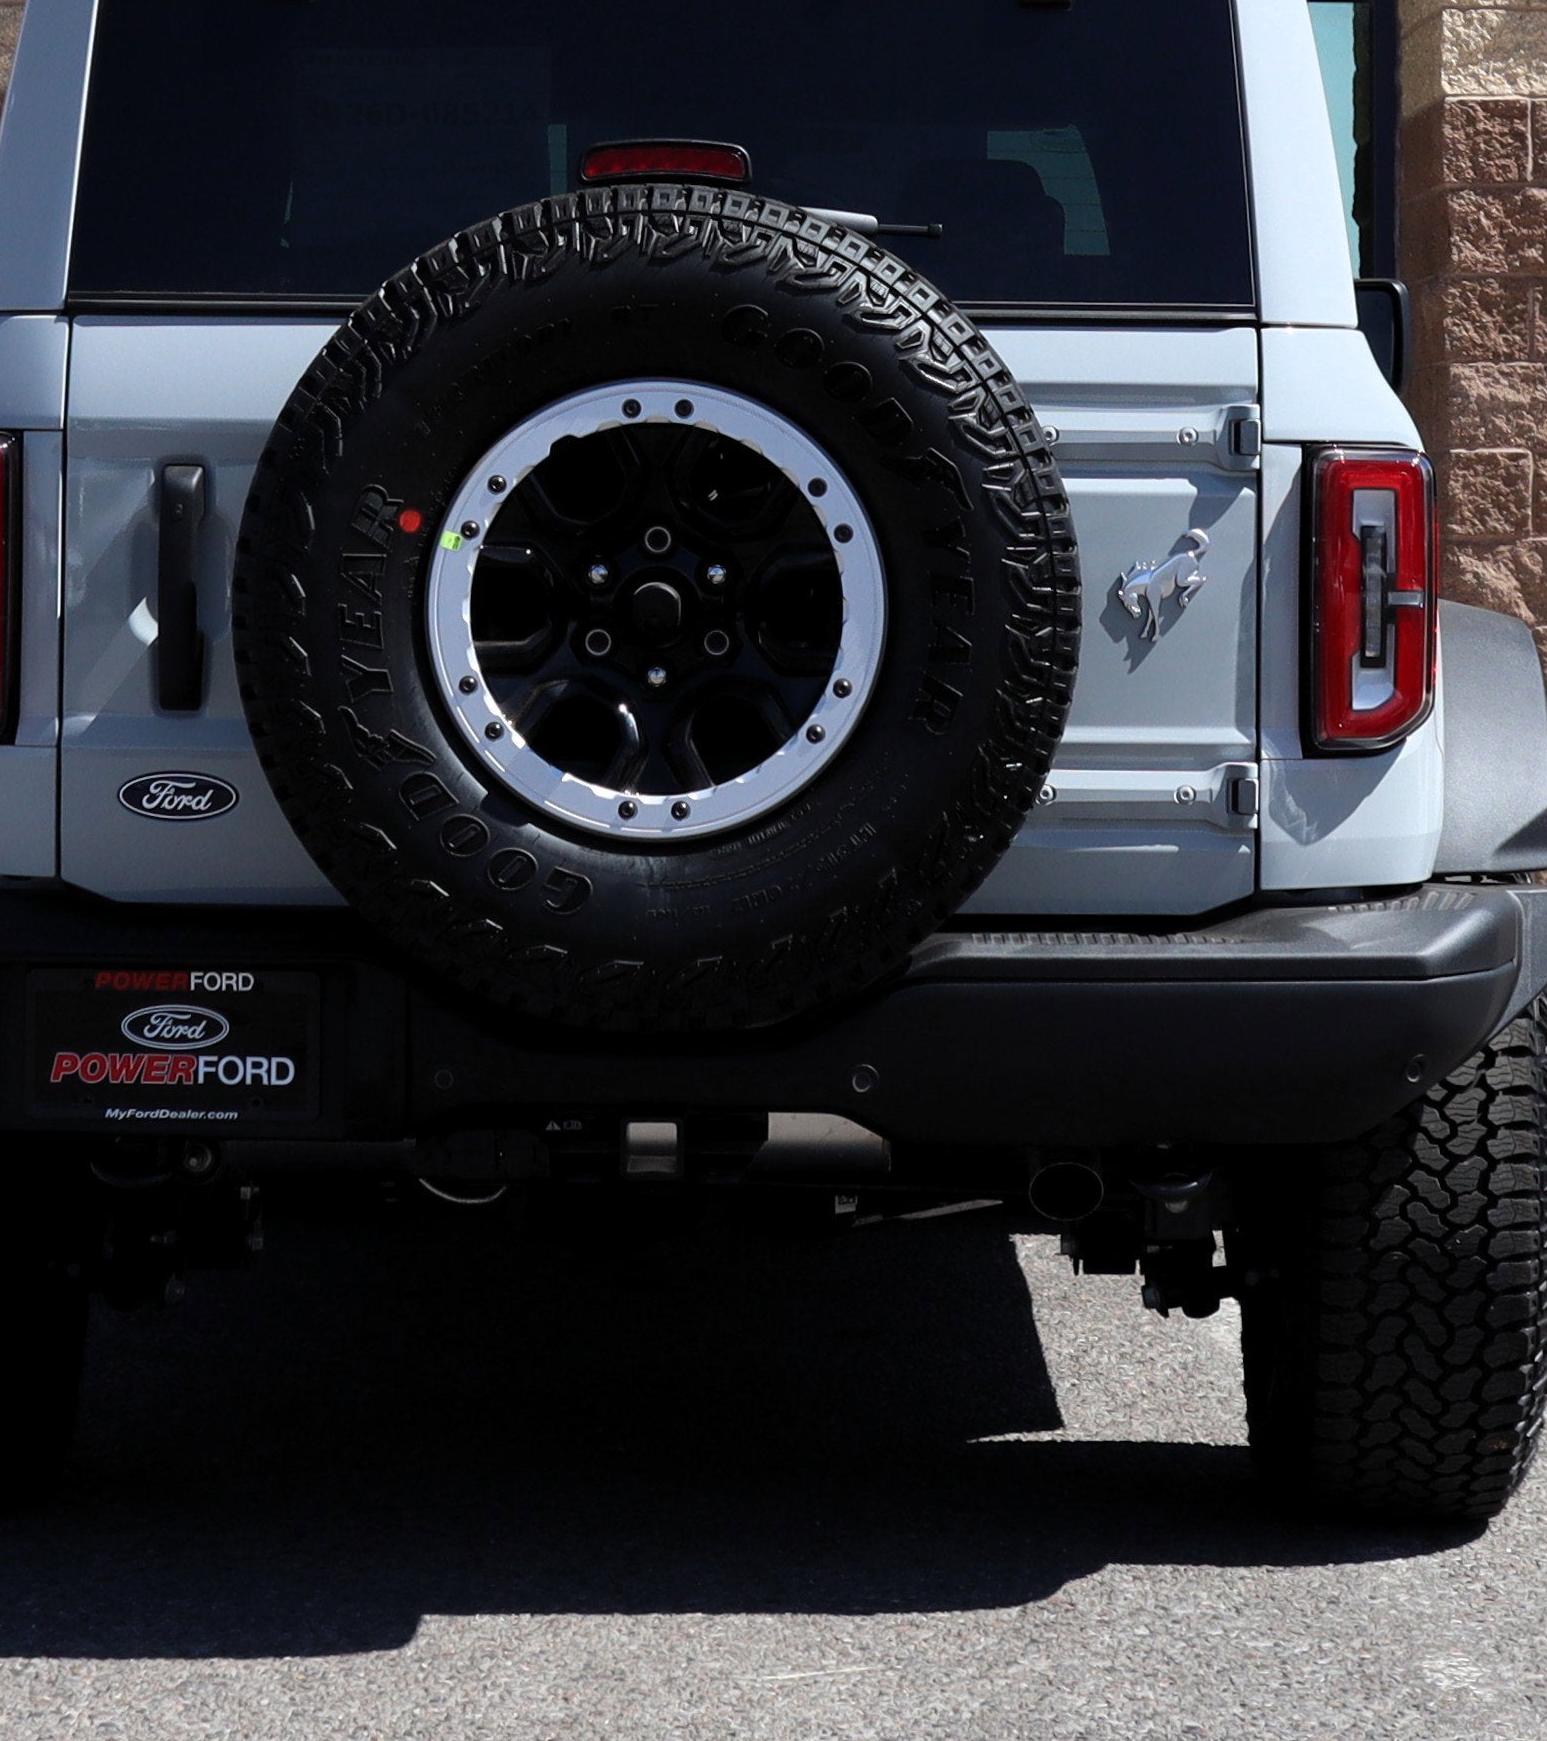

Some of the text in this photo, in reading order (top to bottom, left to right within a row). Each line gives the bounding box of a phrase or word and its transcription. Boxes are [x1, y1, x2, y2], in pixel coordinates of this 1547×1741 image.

[141, 779, 215, 811] Ford
[143, 1012, 207, 1040] Ford
[105, 1108, 239, 1121] MyFordDealer.com
